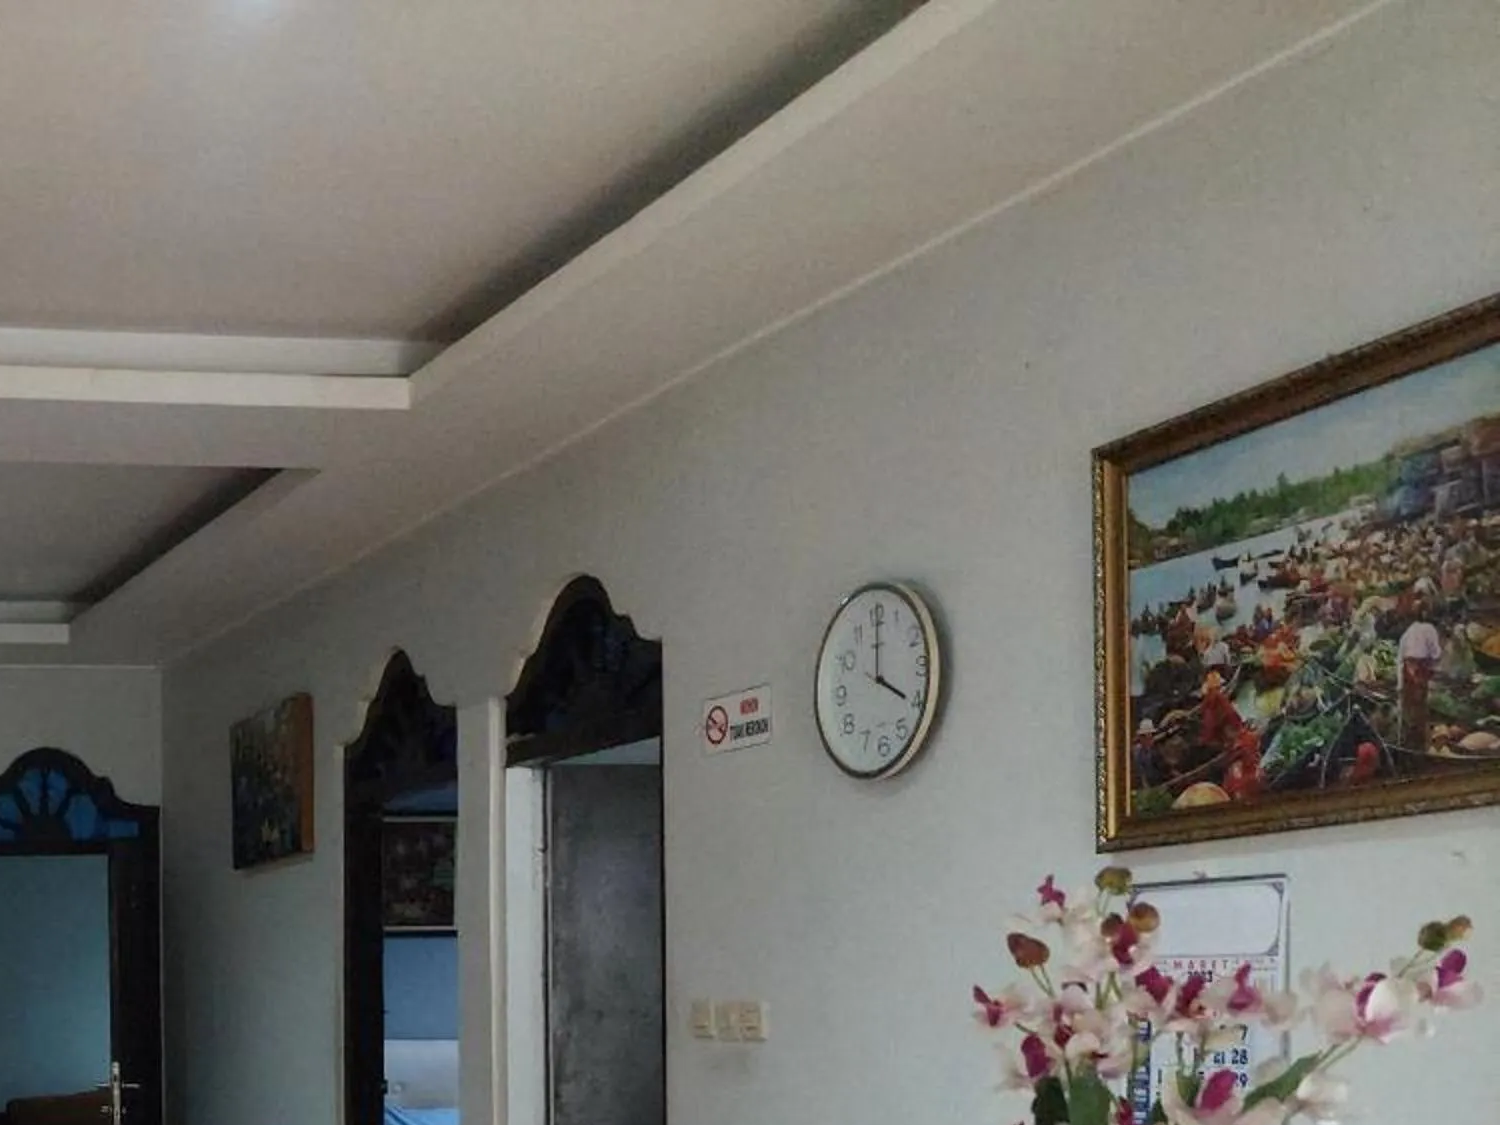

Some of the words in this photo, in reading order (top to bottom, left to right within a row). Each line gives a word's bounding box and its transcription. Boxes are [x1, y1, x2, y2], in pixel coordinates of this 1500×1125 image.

[836, 685, 847, 706] 9
[842, 714, 855, 735] 8
[859, 729, 871, 752] 7
[877, 735, 891, 757] 6
[1231, 1048, 1248, 1065] 28
